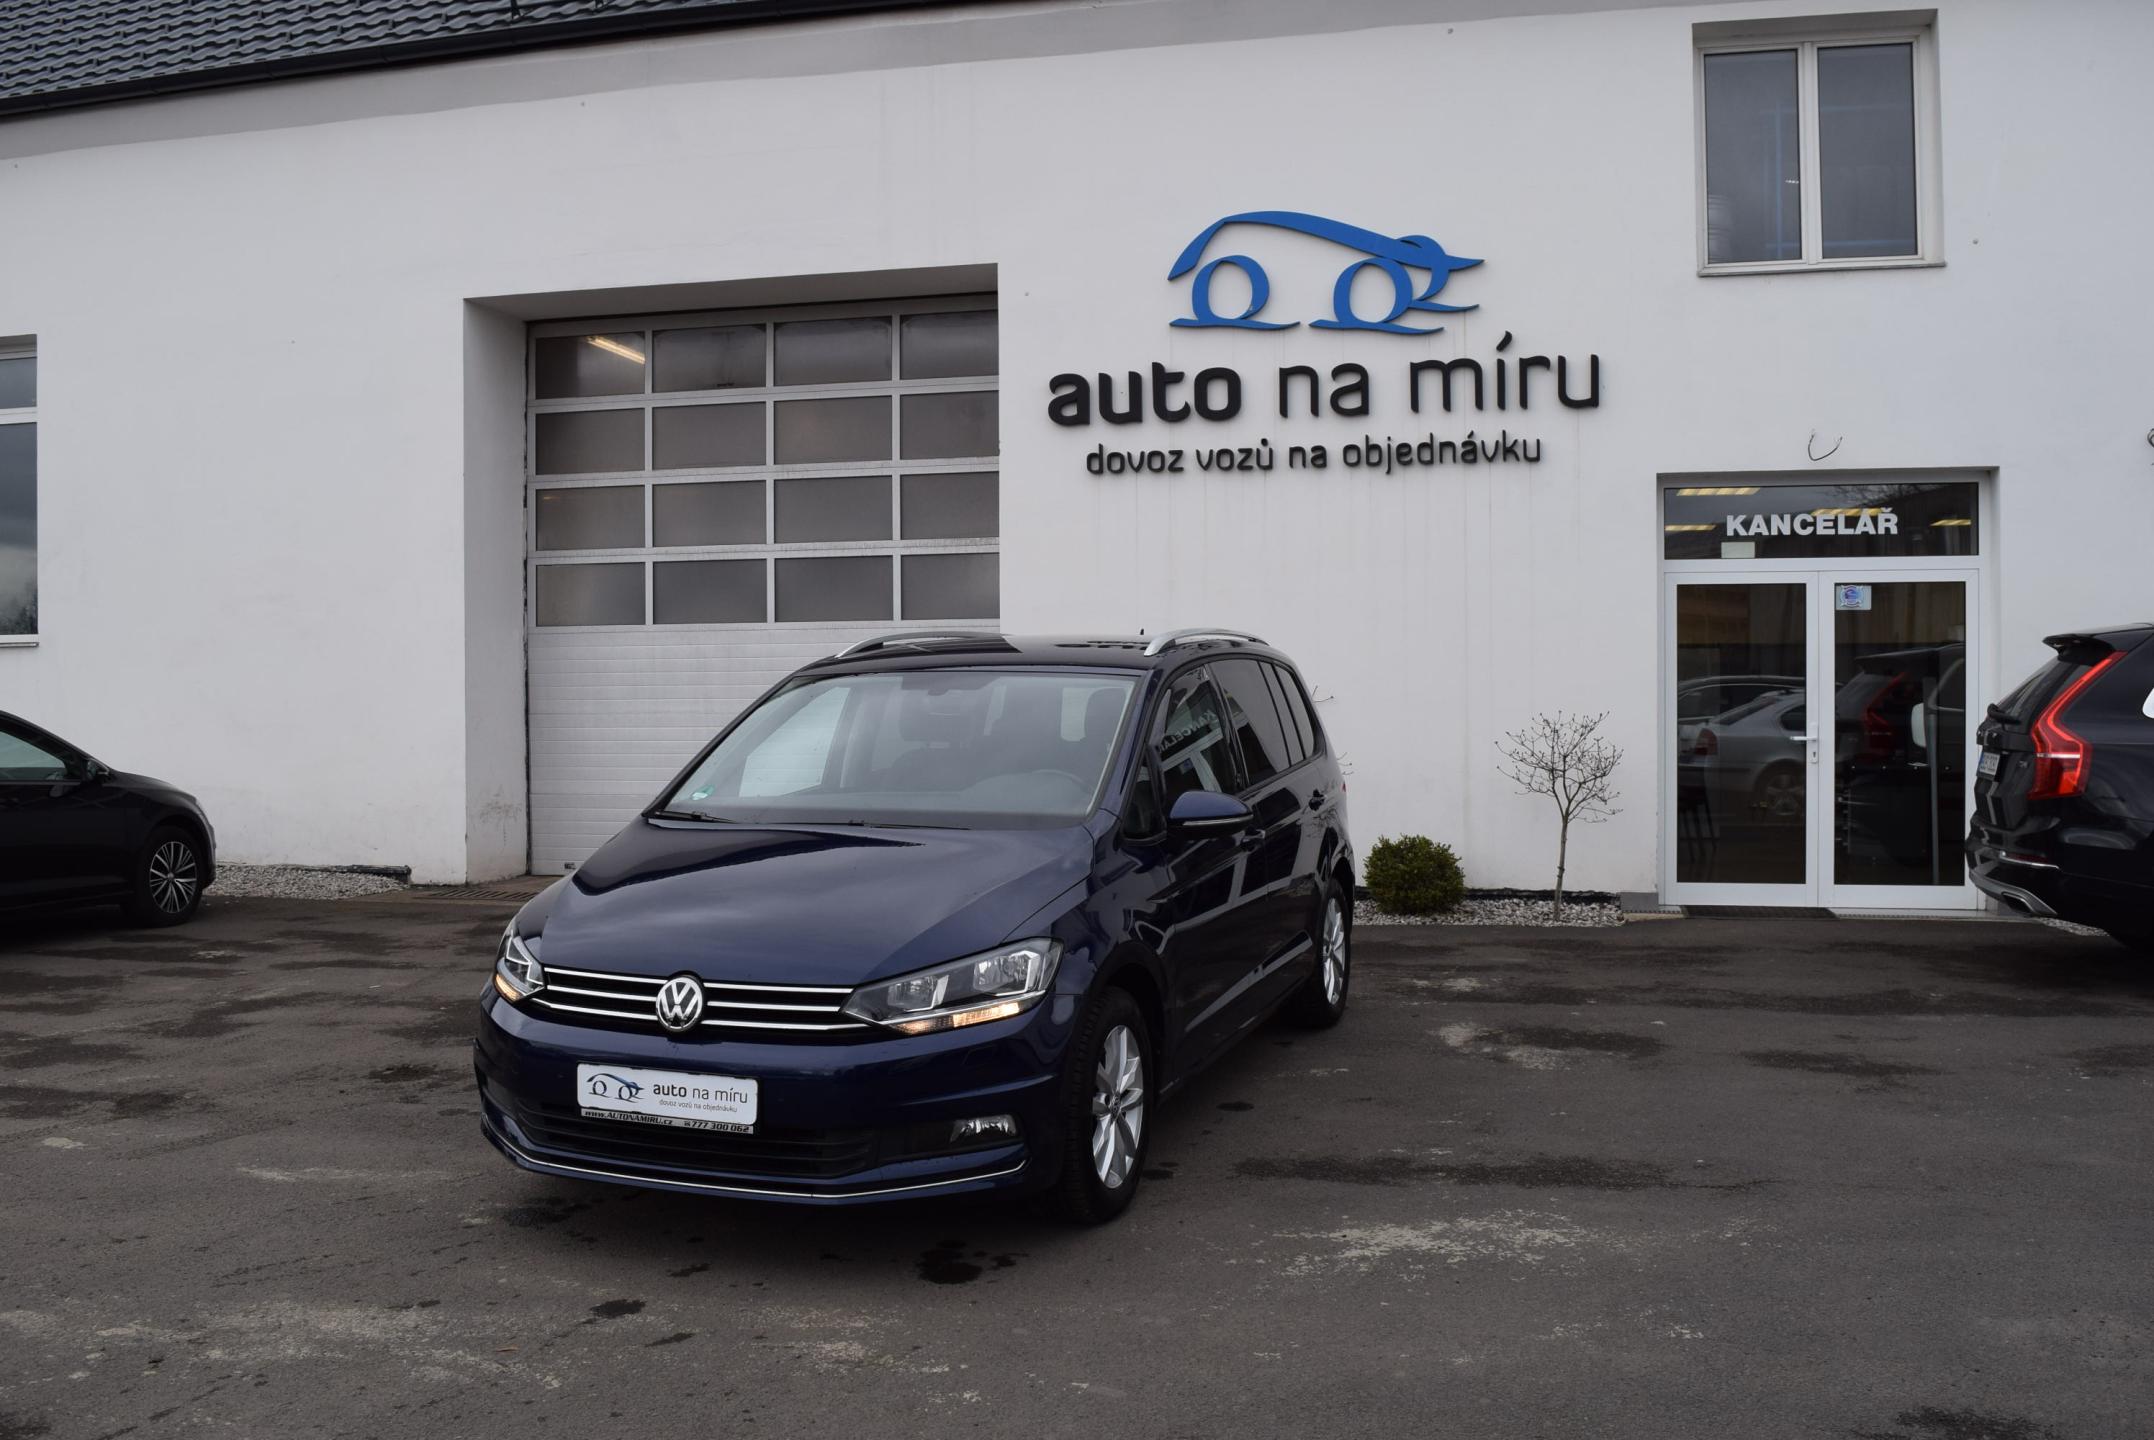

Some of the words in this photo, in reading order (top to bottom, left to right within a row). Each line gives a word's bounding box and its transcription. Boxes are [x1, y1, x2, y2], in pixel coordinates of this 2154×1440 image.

[1048, 362, 1242, 426] auto
[1279, 363, 1370, 419] na
[1410, 331, 1600, 414] míru
[1086, 443, 1184, 476] dovoz
[1196, 438, 1274, 472] vozů
[1288, 446, 1328, 469] na
[1343, 430, 1541, 475] objednávku
[652, 1083, 687, 1098] auto
[692, 1088, 709, 1100] na
[714, 1087, 748, 1104] míru
[692, 1120, 708, 1128] 777
